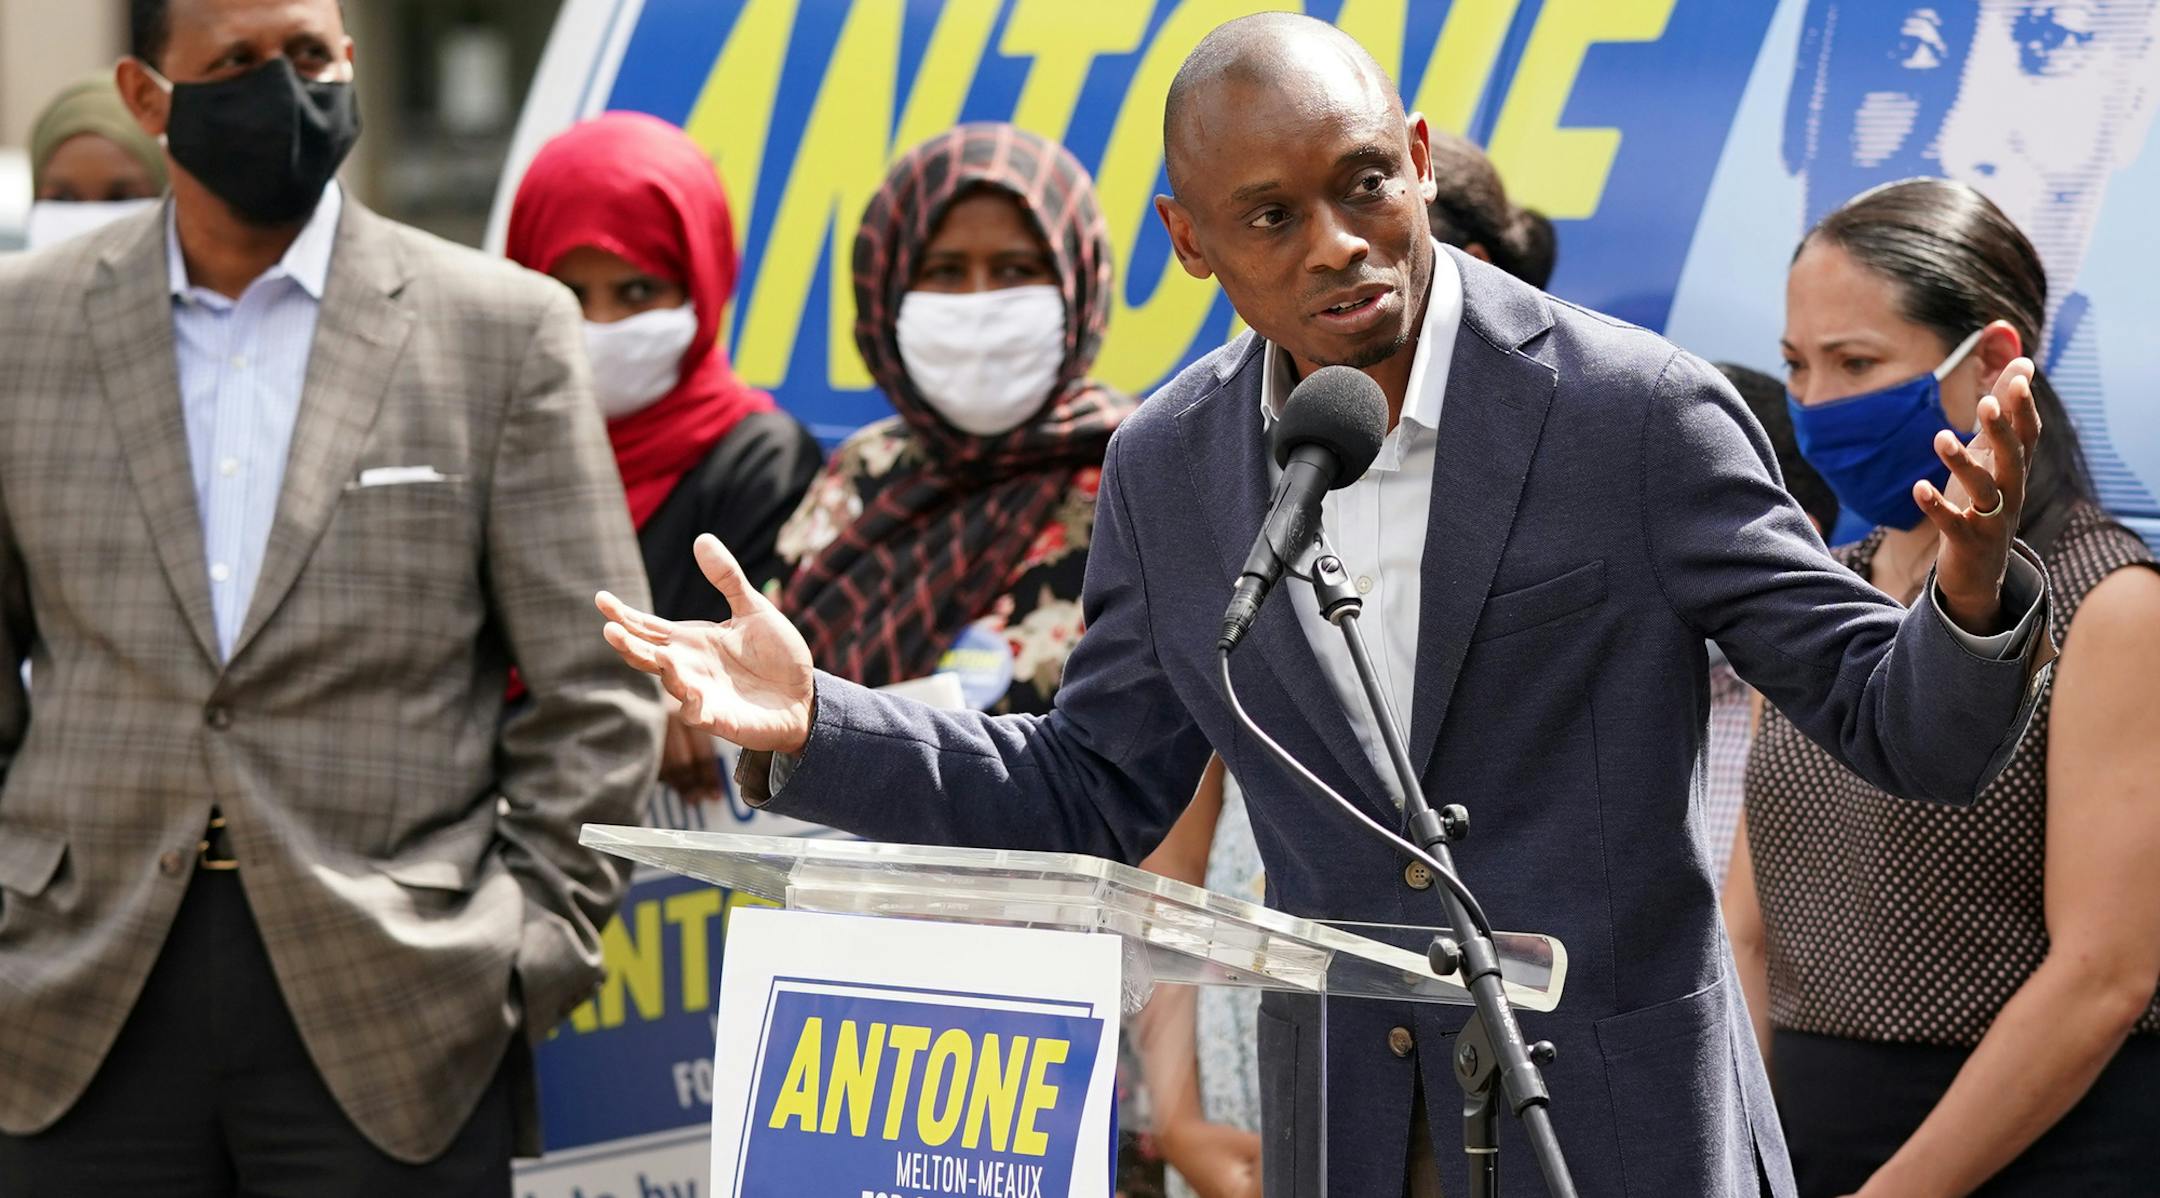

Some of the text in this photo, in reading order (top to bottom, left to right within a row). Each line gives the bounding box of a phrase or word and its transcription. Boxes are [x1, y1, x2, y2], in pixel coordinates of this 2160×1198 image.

[547, 887, 785, 1040] NT
[768, 1016, 1070, 1155] ANTONE
[895, 1151, 1043, 1198] MELTON-MEAUX
